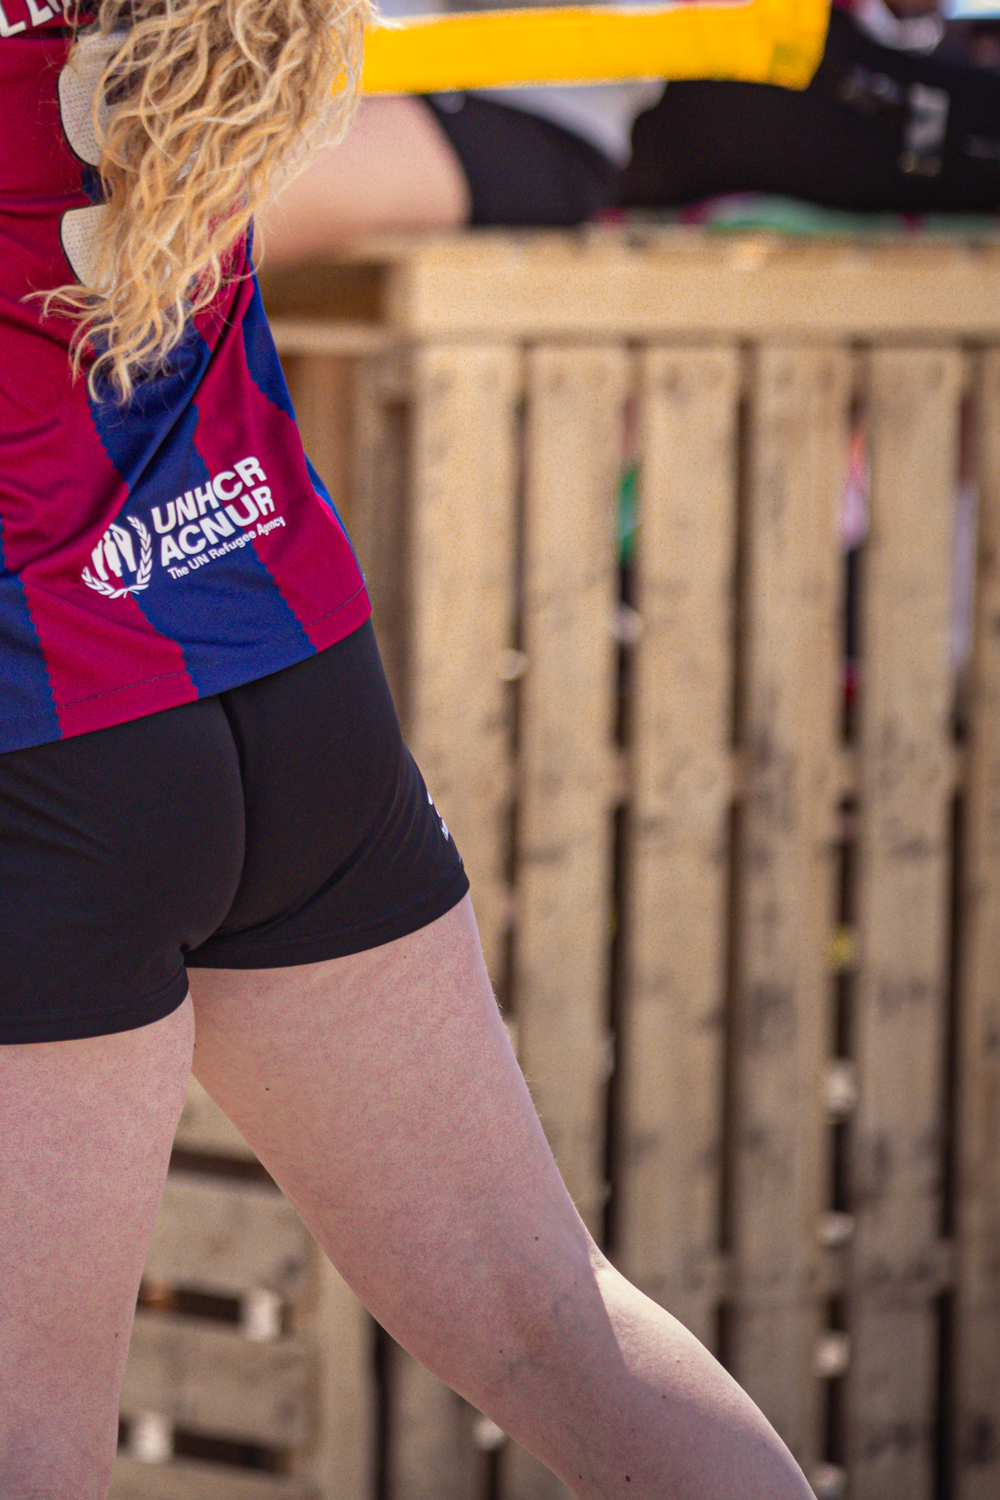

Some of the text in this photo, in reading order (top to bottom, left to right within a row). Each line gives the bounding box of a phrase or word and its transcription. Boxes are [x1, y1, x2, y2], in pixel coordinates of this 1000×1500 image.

[151, 456, 267, 534] UNHCR
[161, 486, 276, 567] ACNUR
[167, 516, 286, 580] The UN Refugee Agency
